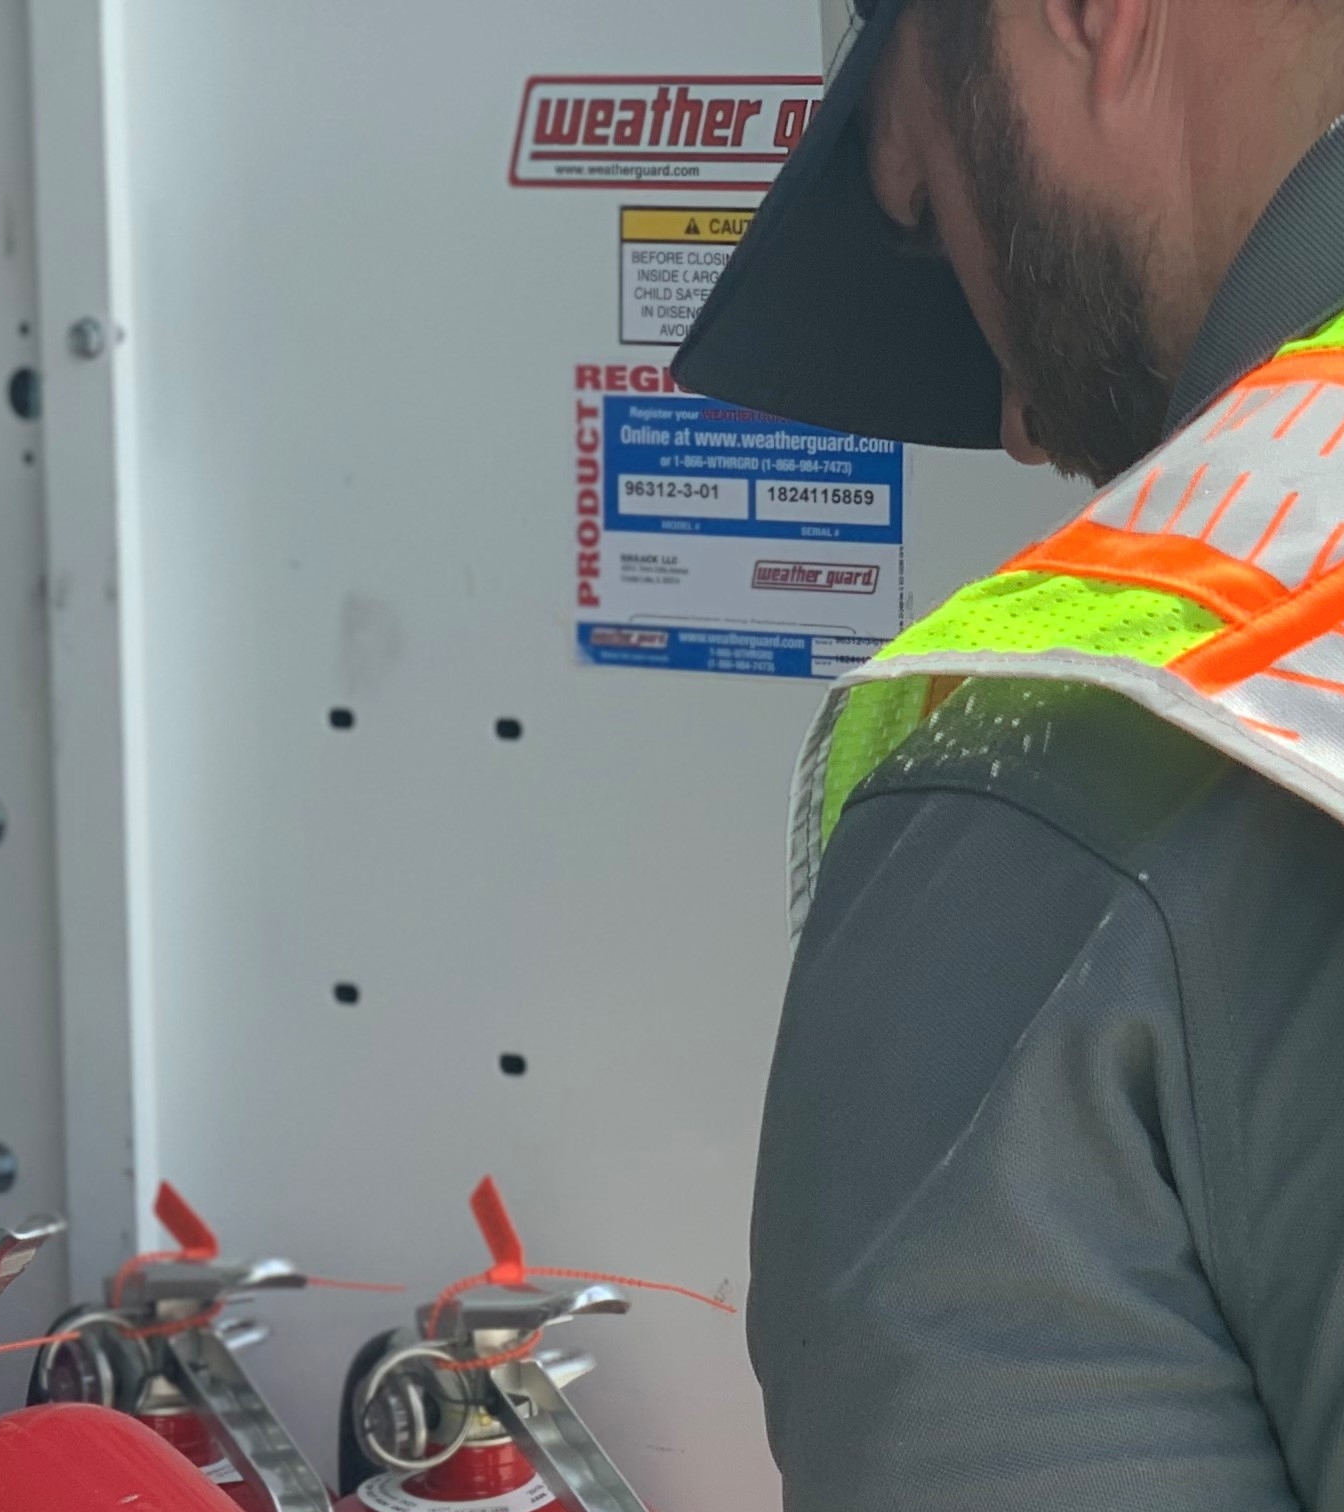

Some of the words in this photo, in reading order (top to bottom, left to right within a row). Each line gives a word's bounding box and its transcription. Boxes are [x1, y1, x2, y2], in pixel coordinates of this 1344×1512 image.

[533, 86, 762, 147] weather
[555, 164, 700, 180] www.weatherguard.com
[631, 251, 683, 264] BEFORE
[638, 270, 679, 283] INSIDE
[683, 270, 719, 284] CARG
[634, 287, 672, 301] CHILD
[641, 306, 654, 318] IN
[629, 407, 673, 421] Register
[675, 410, 699, 423] your
[620, 425, 670, 445] Online
[674, 427, 691, 446] at
[695, 430, 895, 455] www.weatherguard.com
[660, 457, 671, 467] or
[625, 481, 719, 500] 96312-3-01
[767, 487, 874, 506] 1824115859
[576, 400, 601, 607] PRODUCT
[756, 565, 823, 585] weather
[826, 571, 873, 588] guard
[679, 632, 805, 650] www.weatherguard.com
